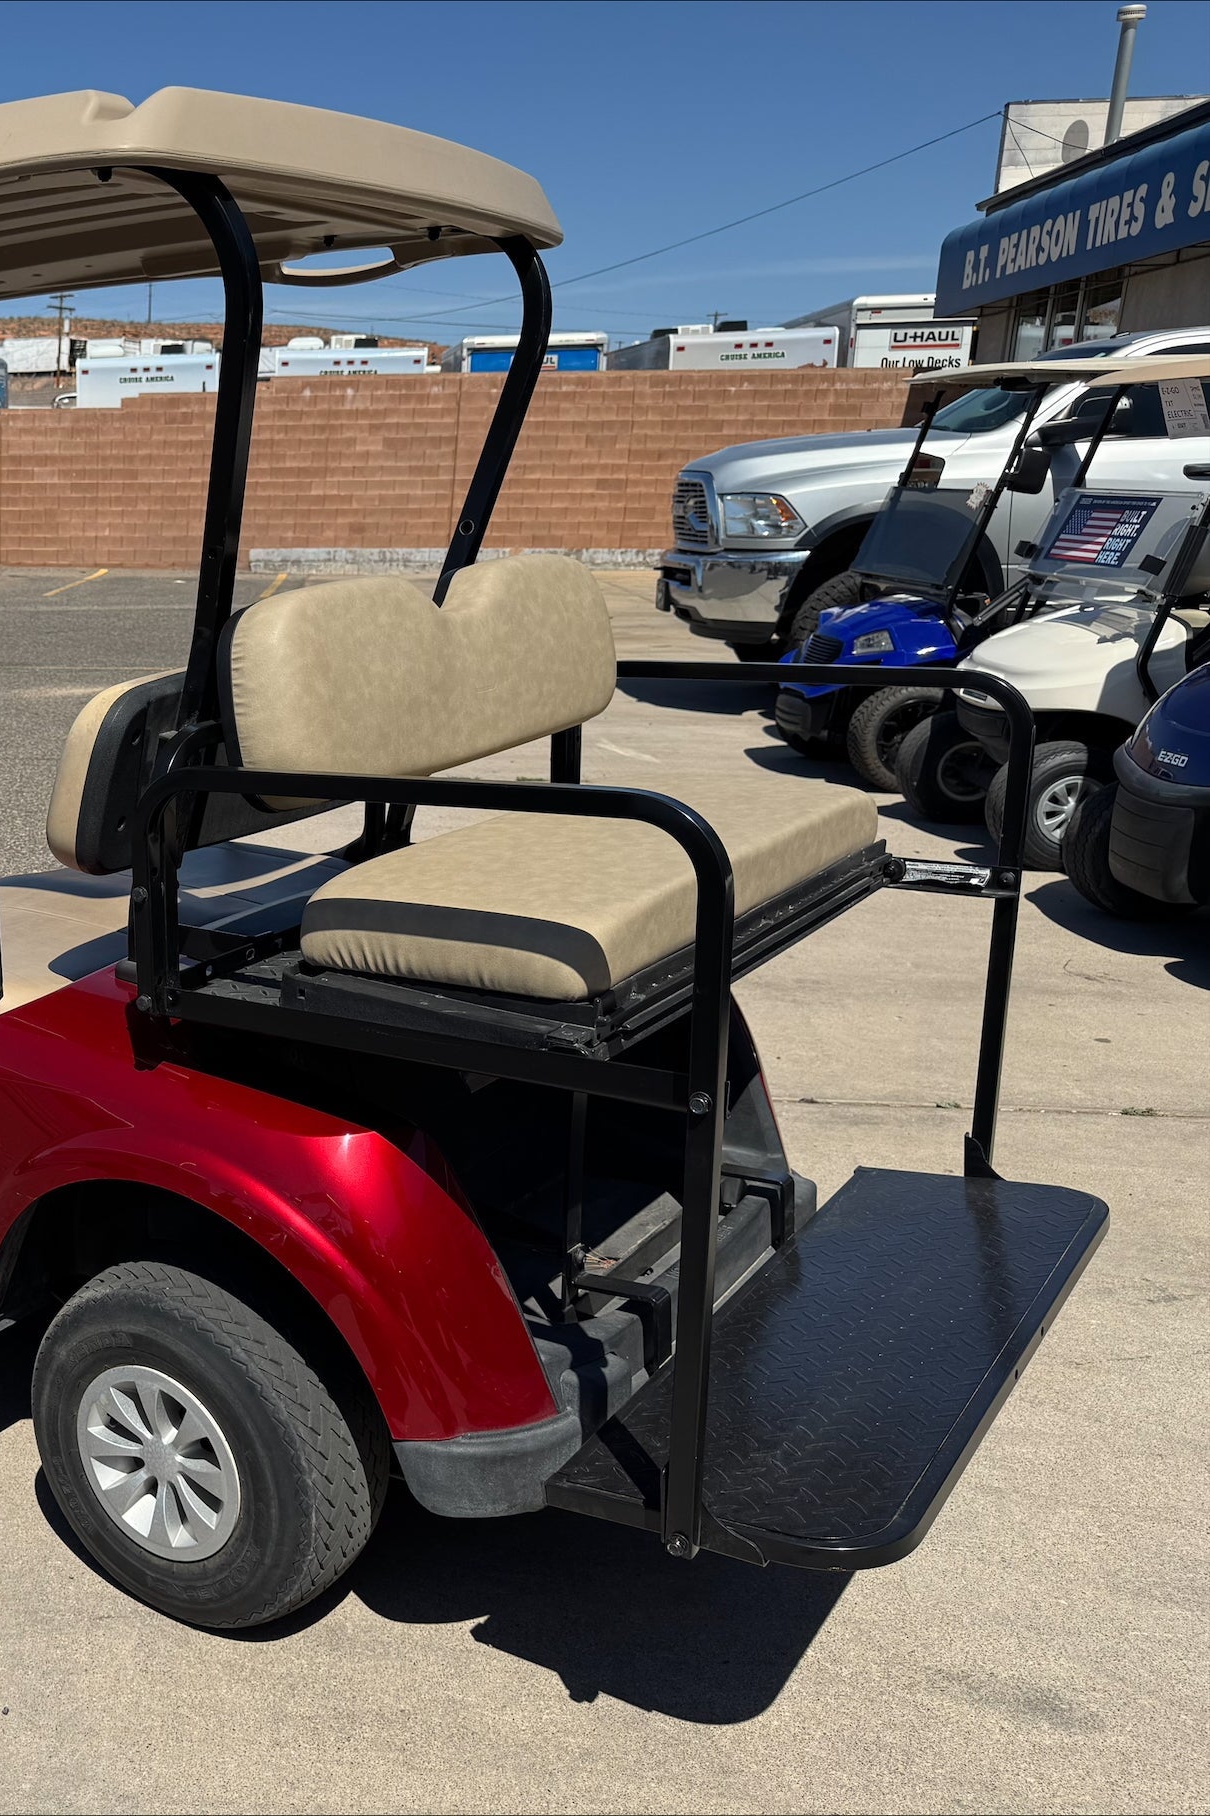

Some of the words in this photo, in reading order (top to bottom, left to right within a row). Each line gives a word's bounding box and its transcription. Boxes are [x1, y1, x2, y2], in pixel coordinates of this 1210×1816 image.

[962, 244, 989, 289] B.T.
[995, 210, 1081, 279] PEARSON
[1086, 183, 1148, 250] TIRES
[1154, 172, 1176, 229] &
[893, 330, 960, 344] U-HAUL
[720, 352, 748, 361] CRUISE
[751, 351, 785, 360] AMERICA
[881, 357, 900, 368] Our
[902, 356, 924, 368] Low
[927, 355, 961, 368] Decks
[119, 376, 143, 384] CRUISE
[145, 375, 174, 383] AMERICA
[1120, 510, 1147, 523] BUILT
[1111, 524, 1140, 537] RIGHT.
[1103, 537, 1132, 551] RIGHT
[1094, 551, 1121, 565] HERE.
